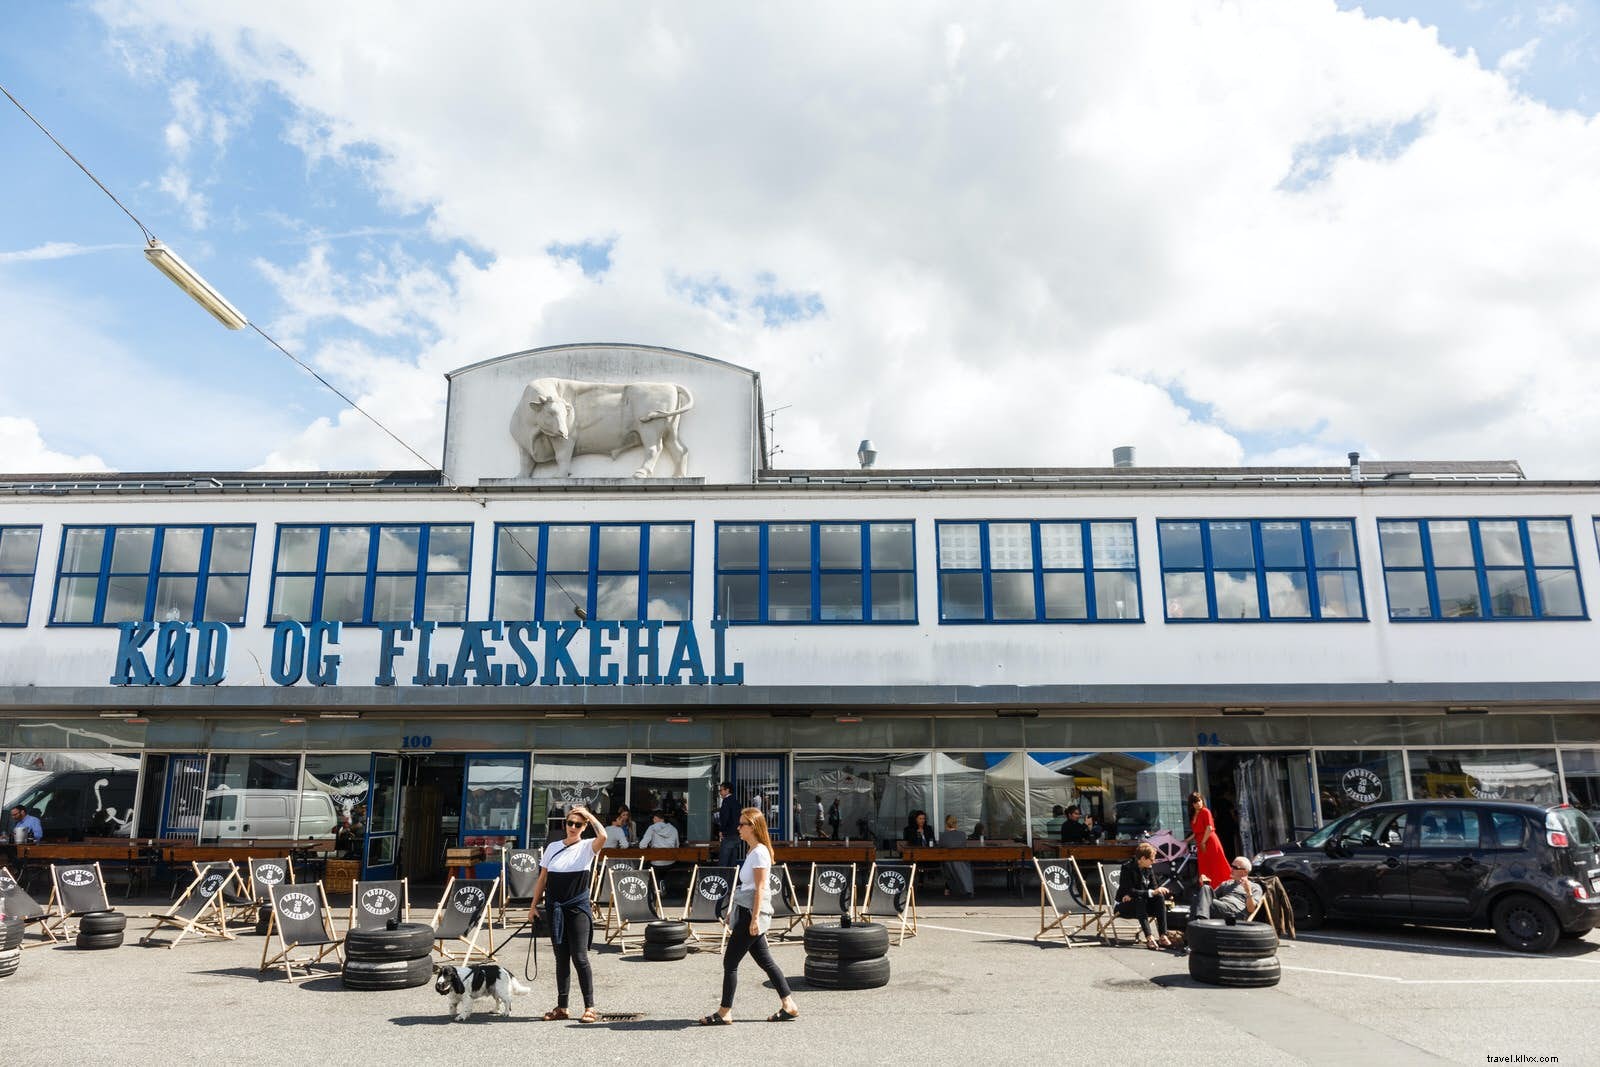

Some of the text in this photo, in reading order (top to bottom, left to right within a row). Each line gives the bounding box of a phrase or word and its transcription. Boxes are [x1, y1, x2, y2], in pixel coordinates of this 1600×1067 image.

[110, 620, 744, 686] KØD OG FLÆSKEHAL
[402, 735, 432, 748] 100
